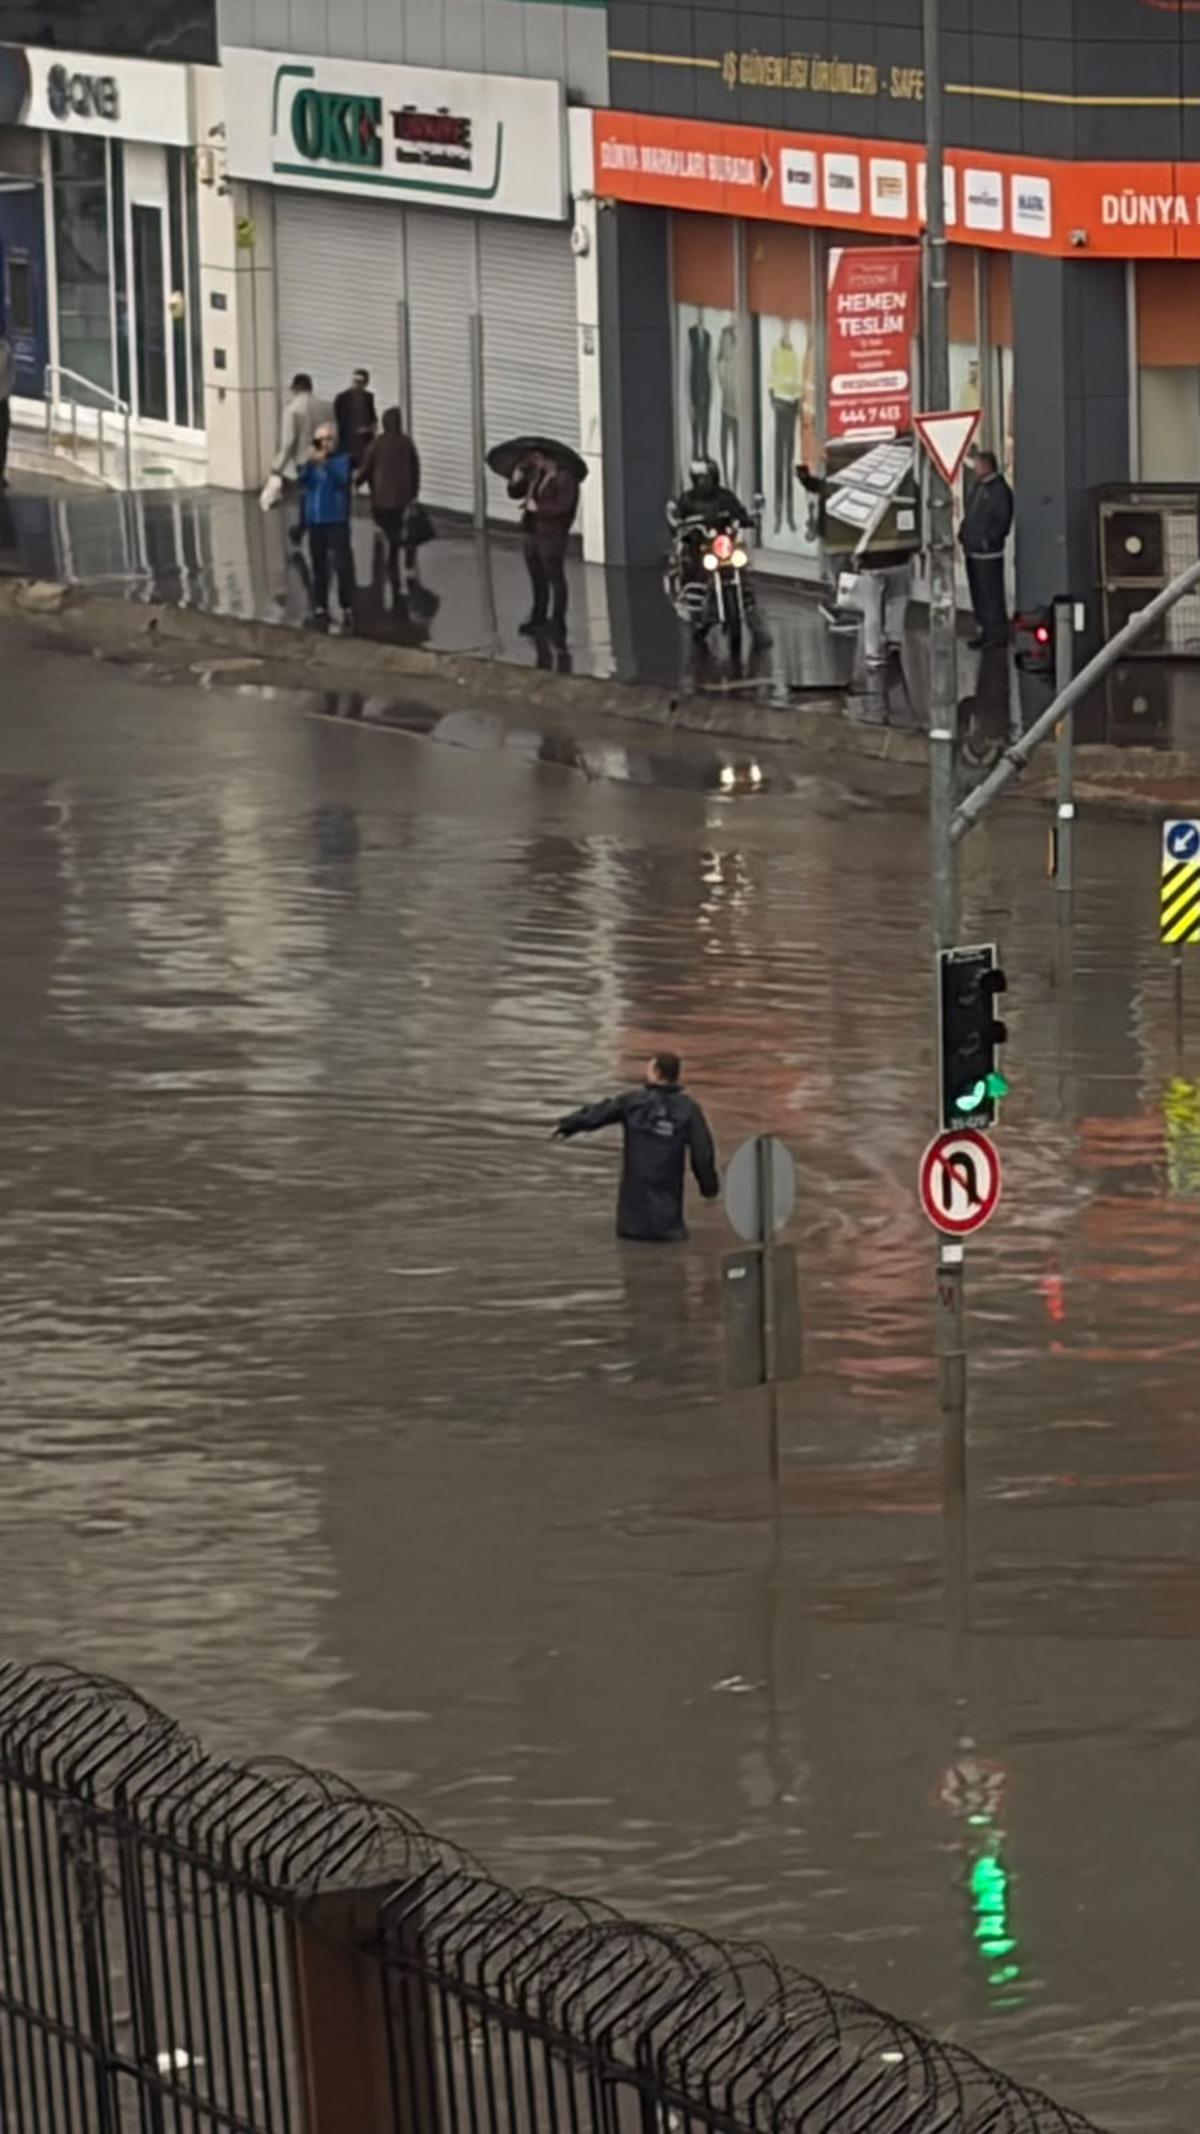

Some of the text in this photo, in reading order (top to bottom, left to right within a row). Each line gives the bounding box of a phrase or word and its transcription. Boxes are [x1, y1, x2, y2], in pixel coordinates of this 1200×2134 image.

[69, 72, 120, 121] QNB
[601, 136, 638, 171] DÜNYA
[708, 153, 757, 186] BURADA
[1101, 188, 1190, 225] DÜNYA
[837, 292, 907, 313] HEMEN
[838, 310, 904, 337] TESLİM
